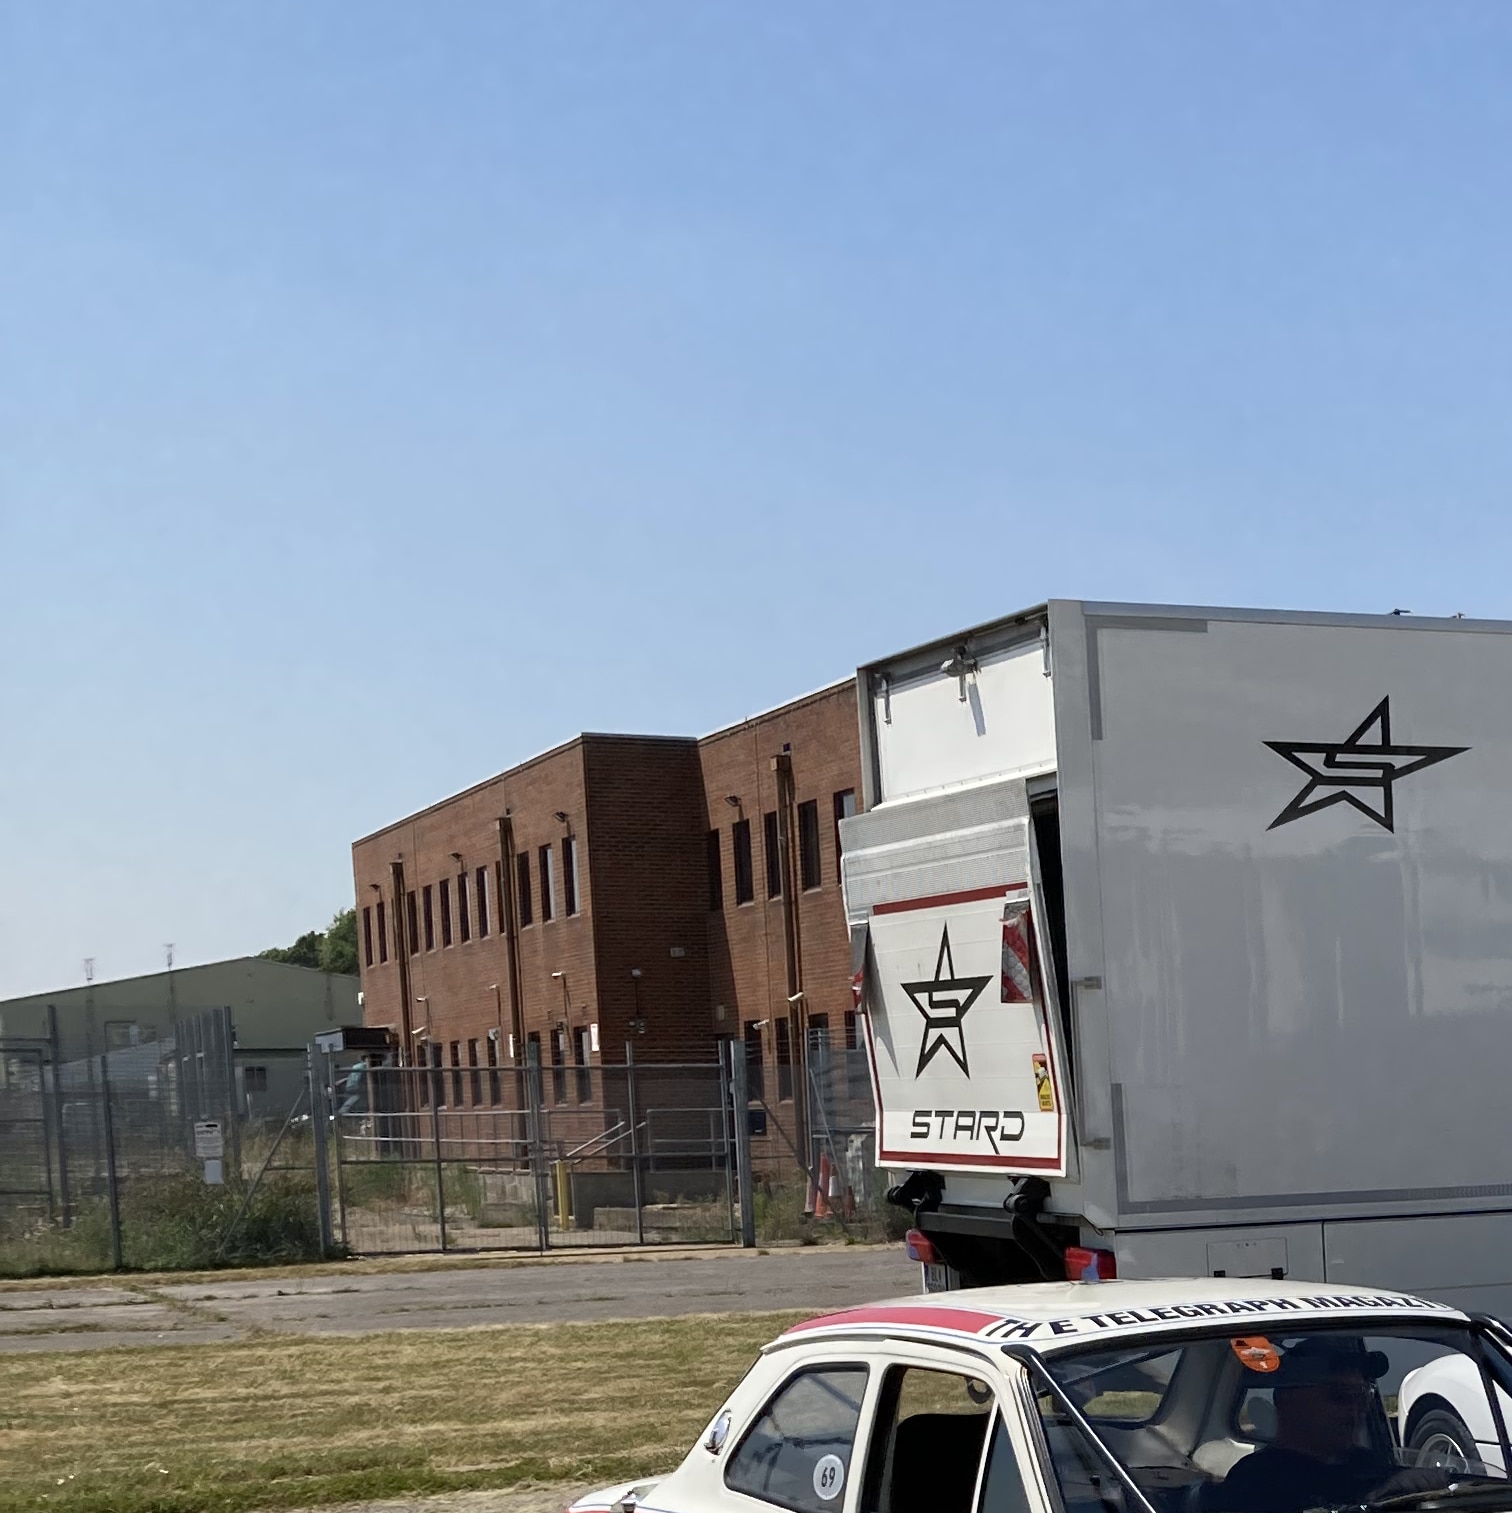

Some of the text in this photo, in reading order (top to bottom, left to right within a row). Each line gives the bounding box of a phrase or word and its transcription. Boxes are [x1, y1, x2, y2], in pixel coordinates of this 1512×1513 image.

[910, 1110, 1025, 1155] STARD
[986, 1319, 1075, 1339] THE
[1081, 1296, 1301, 1329] TELEGRAPH
[821, 1466, 836, 1488] 69
